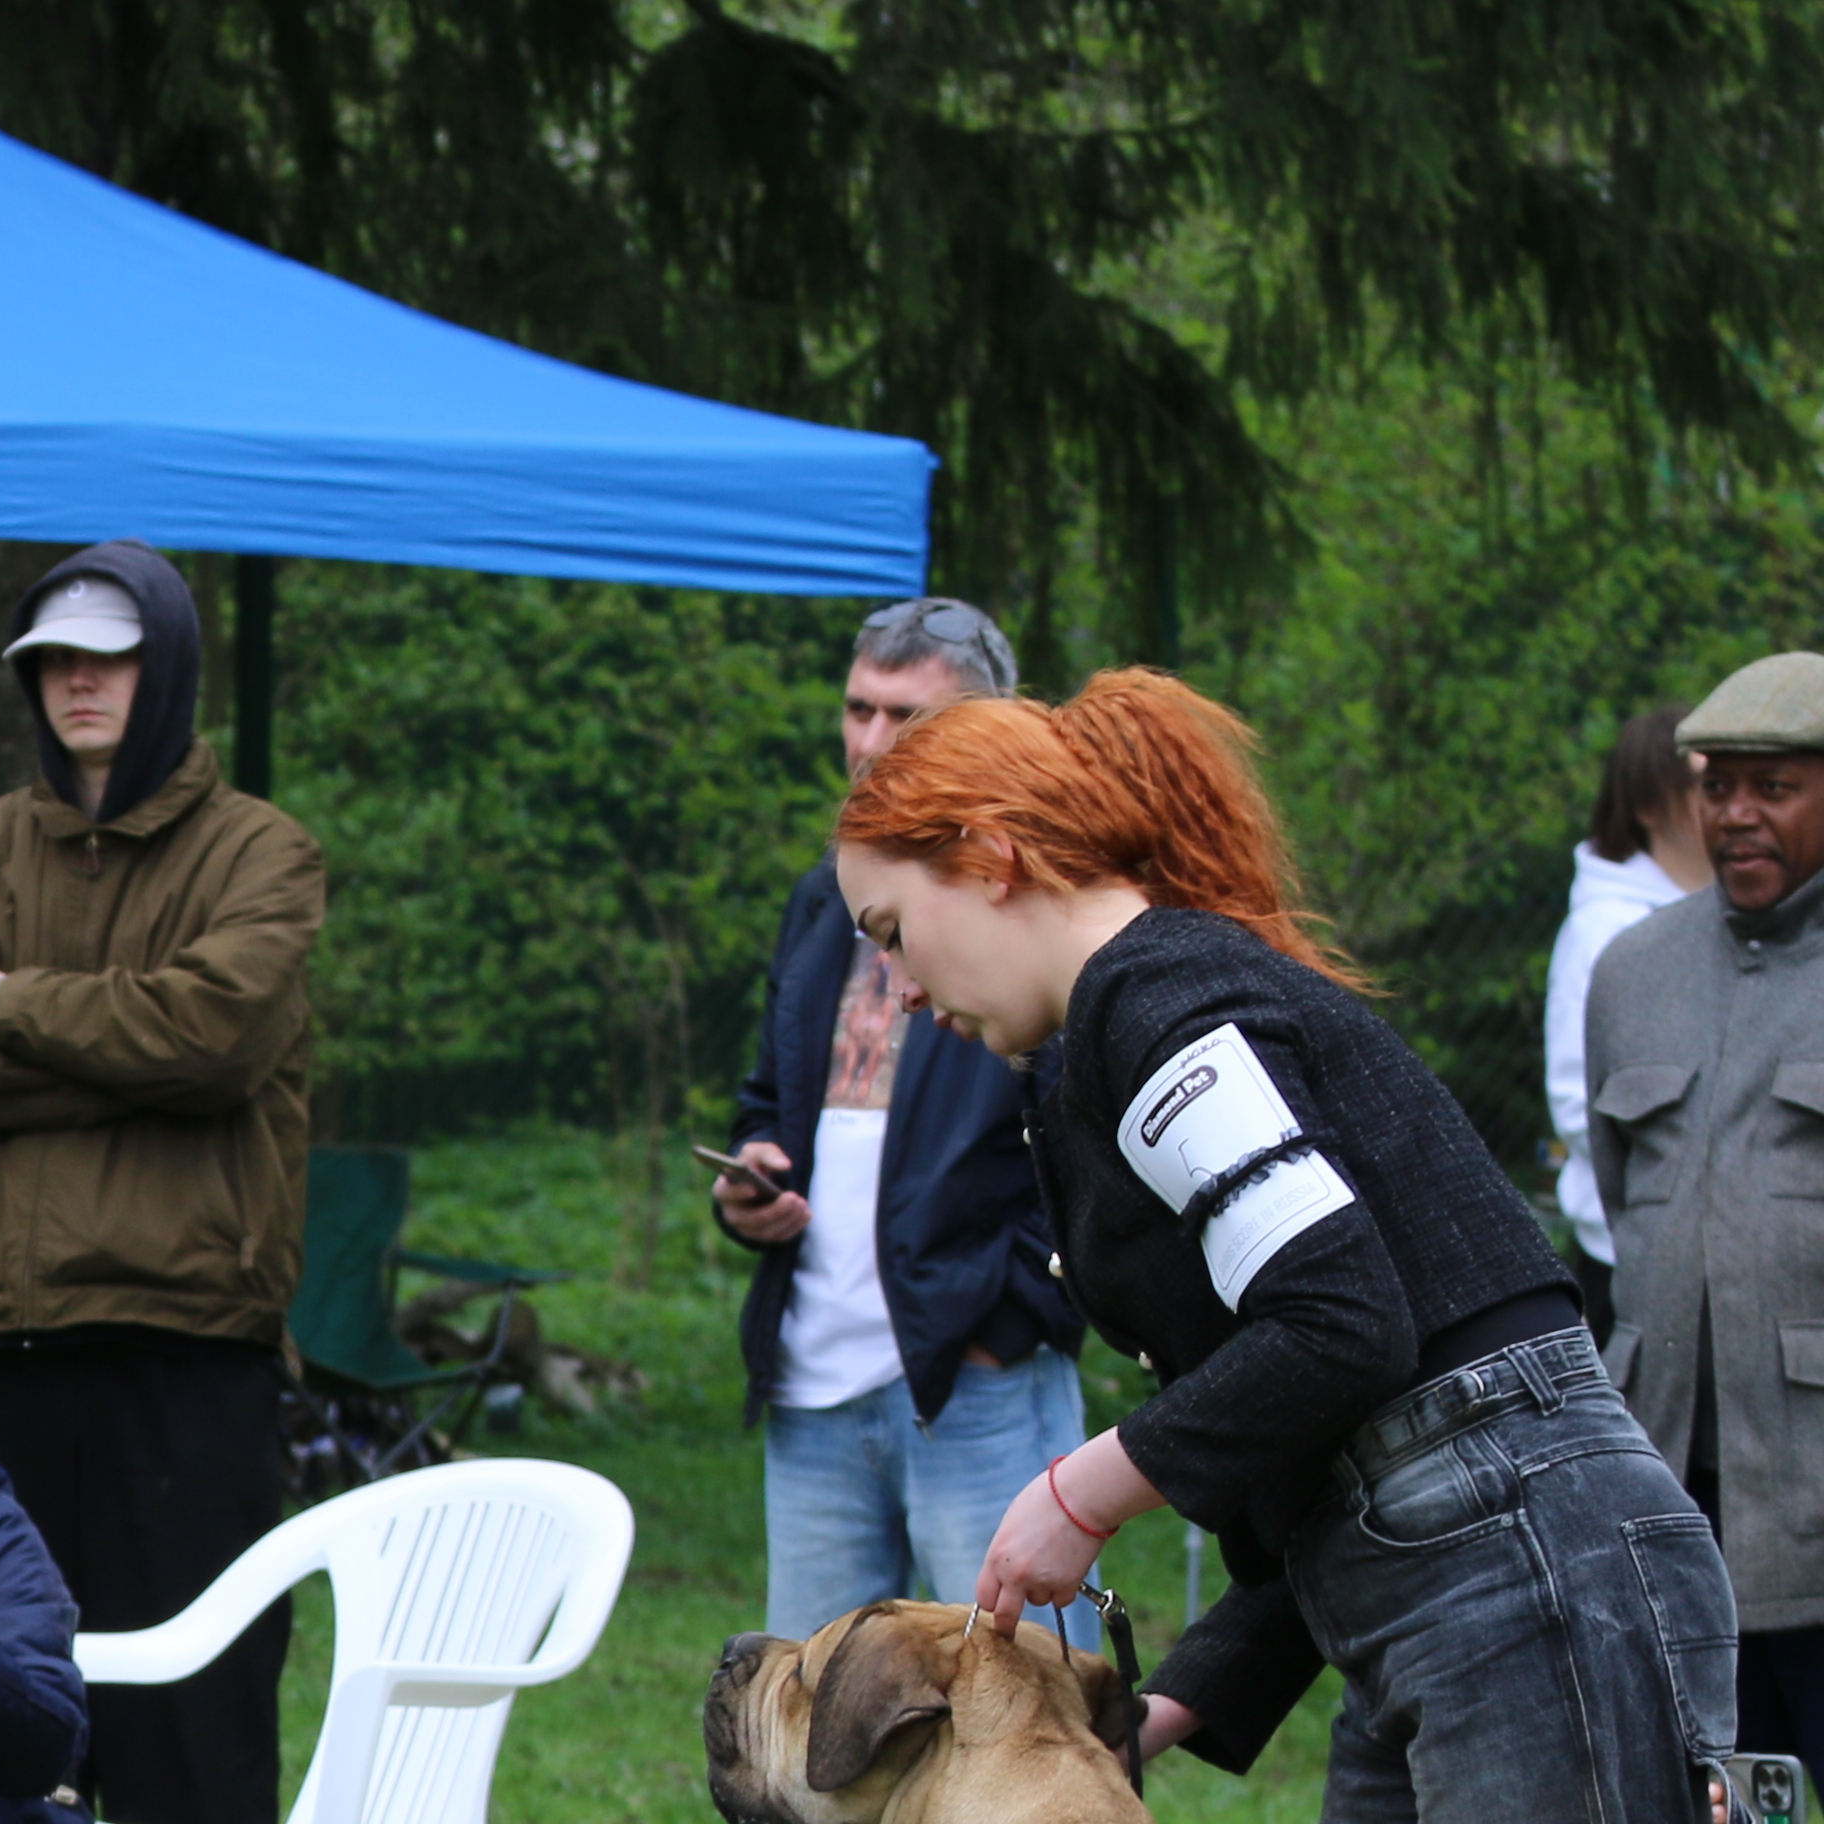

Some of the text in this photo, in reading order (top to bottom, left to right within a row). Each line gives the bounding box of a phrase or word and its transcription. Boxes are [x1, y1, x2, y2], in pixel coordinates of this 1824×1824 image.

[1142, 1069, 1211, 1139] Diamond Pet
[1259, 1205, 1275, 1224] IN
[1273, 1182, 1317, 1213] RUSSIA
